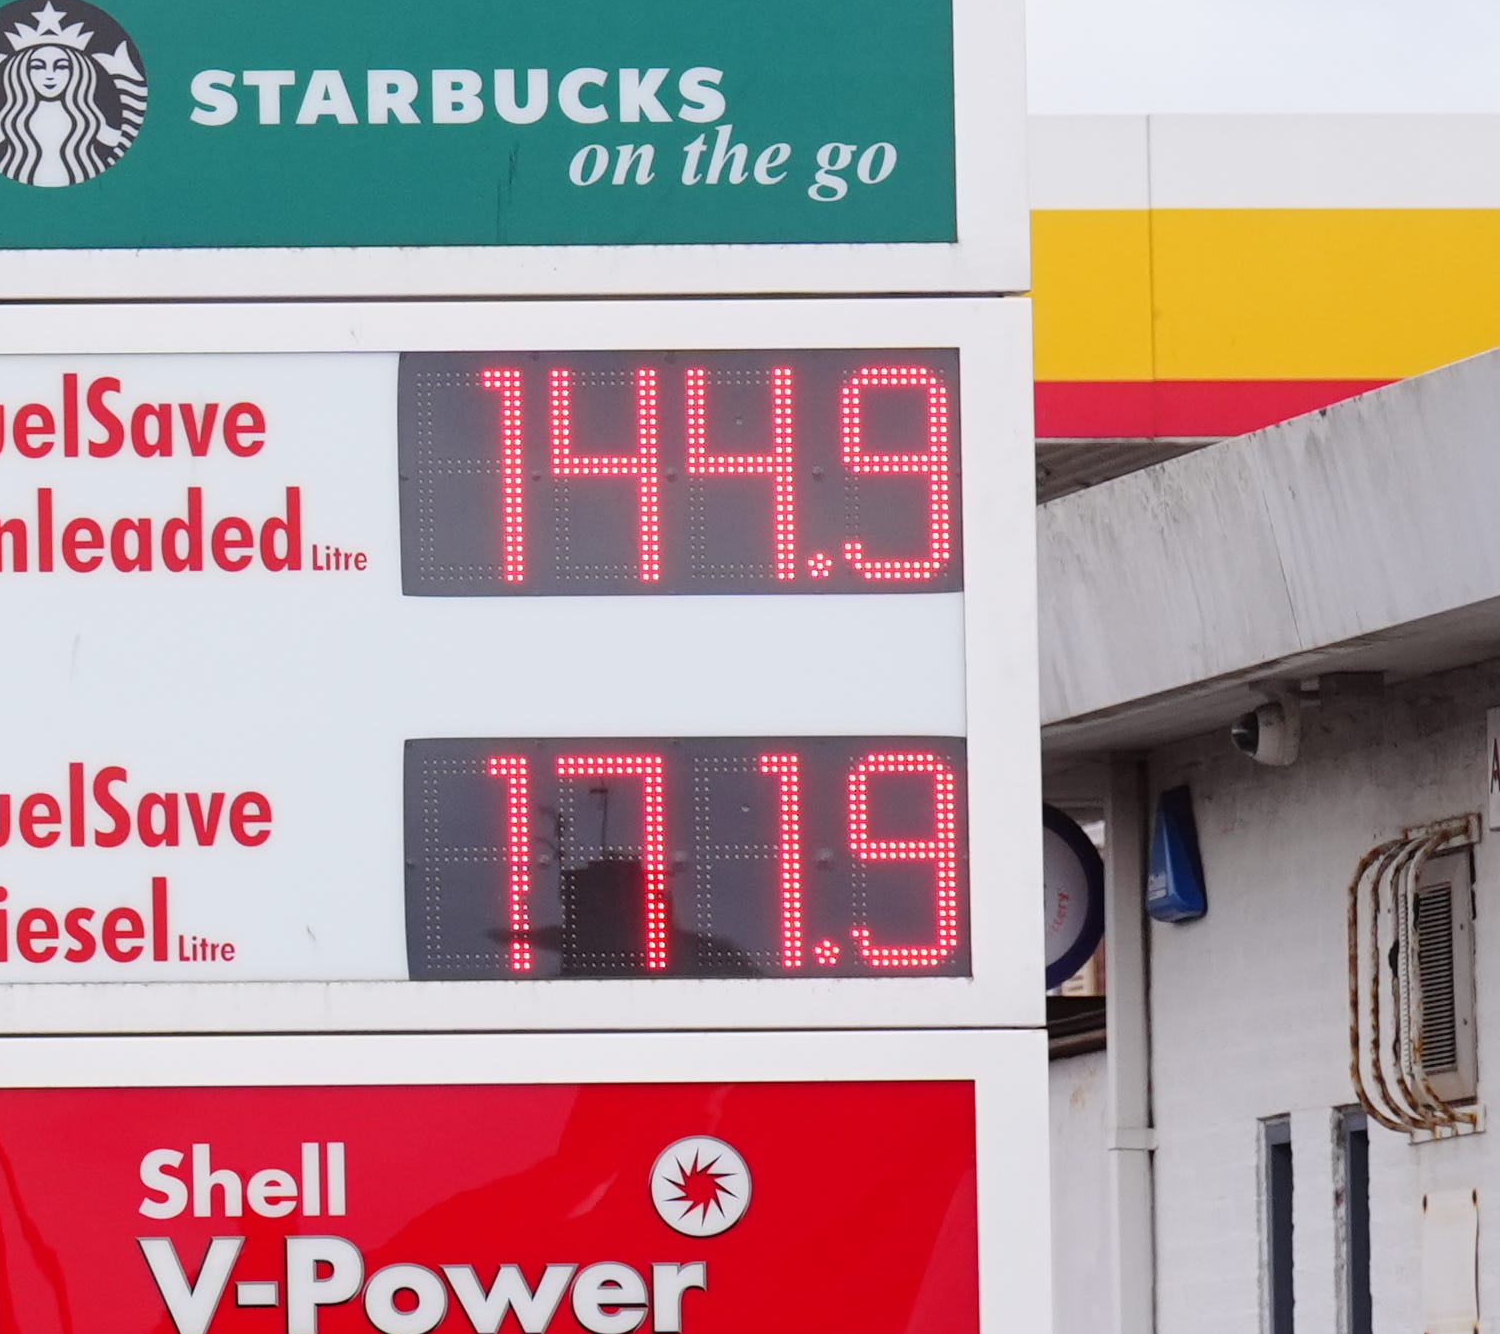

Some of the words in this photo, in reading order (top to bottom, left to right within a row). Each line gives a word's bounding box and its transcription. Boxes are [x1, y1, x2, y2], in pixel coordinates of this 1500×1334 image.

[190, 67, 727, 126] STARBUCKS
[568, 140, 656, 187] on
[678, 126, 790, 186] the
[809, 141, 897, 202] go
[481, 366, 952, 583] 144.9
[311, 543, 368, 573] Litre
[489, 752, 957, 970] 171.9
[178, 934, 235, 964] Litre
[137, 1142, 347, 1220] Shell
